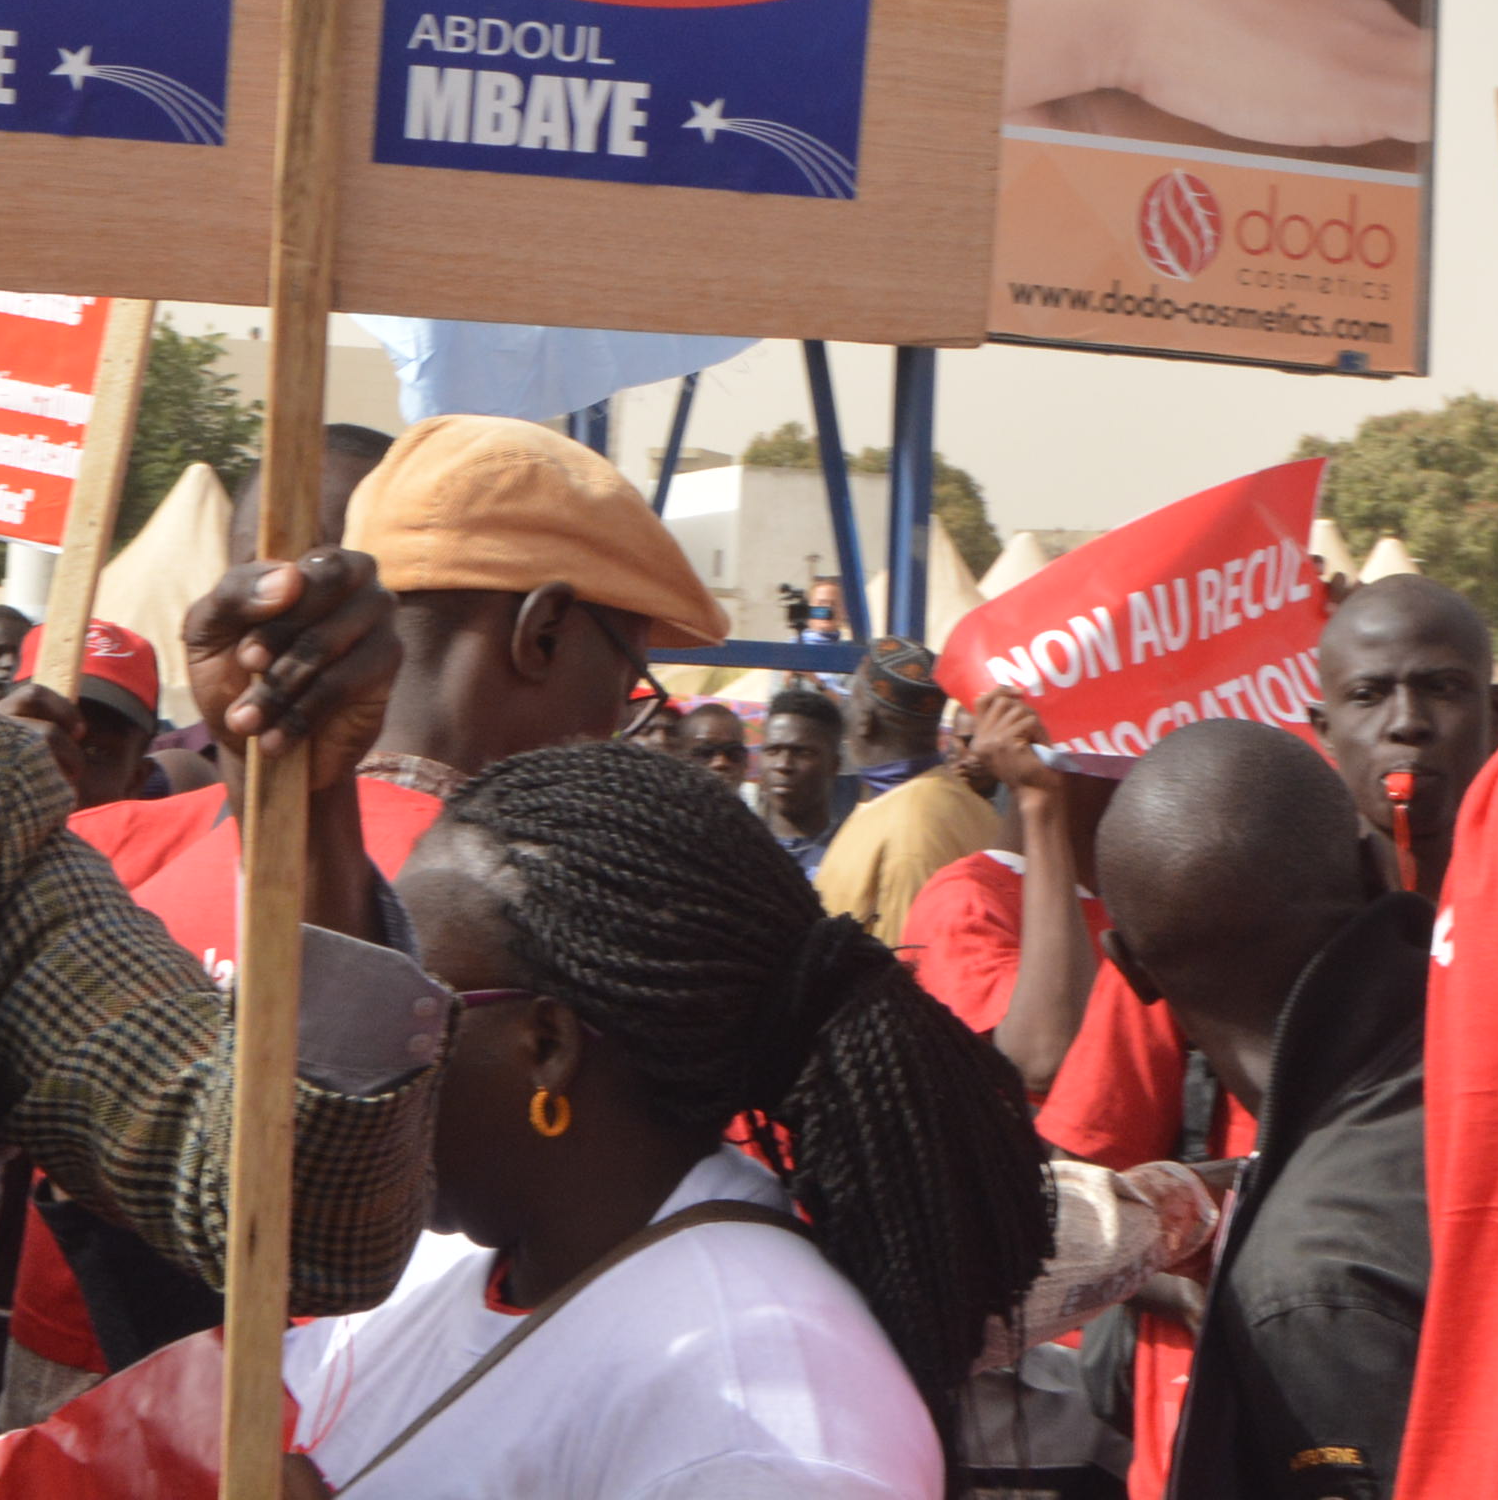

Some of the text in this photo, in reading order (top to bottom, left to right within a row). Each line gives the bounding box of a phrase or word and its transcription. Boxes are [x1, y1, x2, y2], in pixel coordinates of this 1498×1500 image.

[407, 13, 616, 66] ABDOUL
[403, 64, 652, 158] MBAYE
[1236, 184, 1397, 270] dodo
[1008, 280, 1394, 345] www.dodo-cosmetics.com
[1236, 267, 1392, 301] cosmetics
[985, 538, 1311, 698] NON AU RECUL
